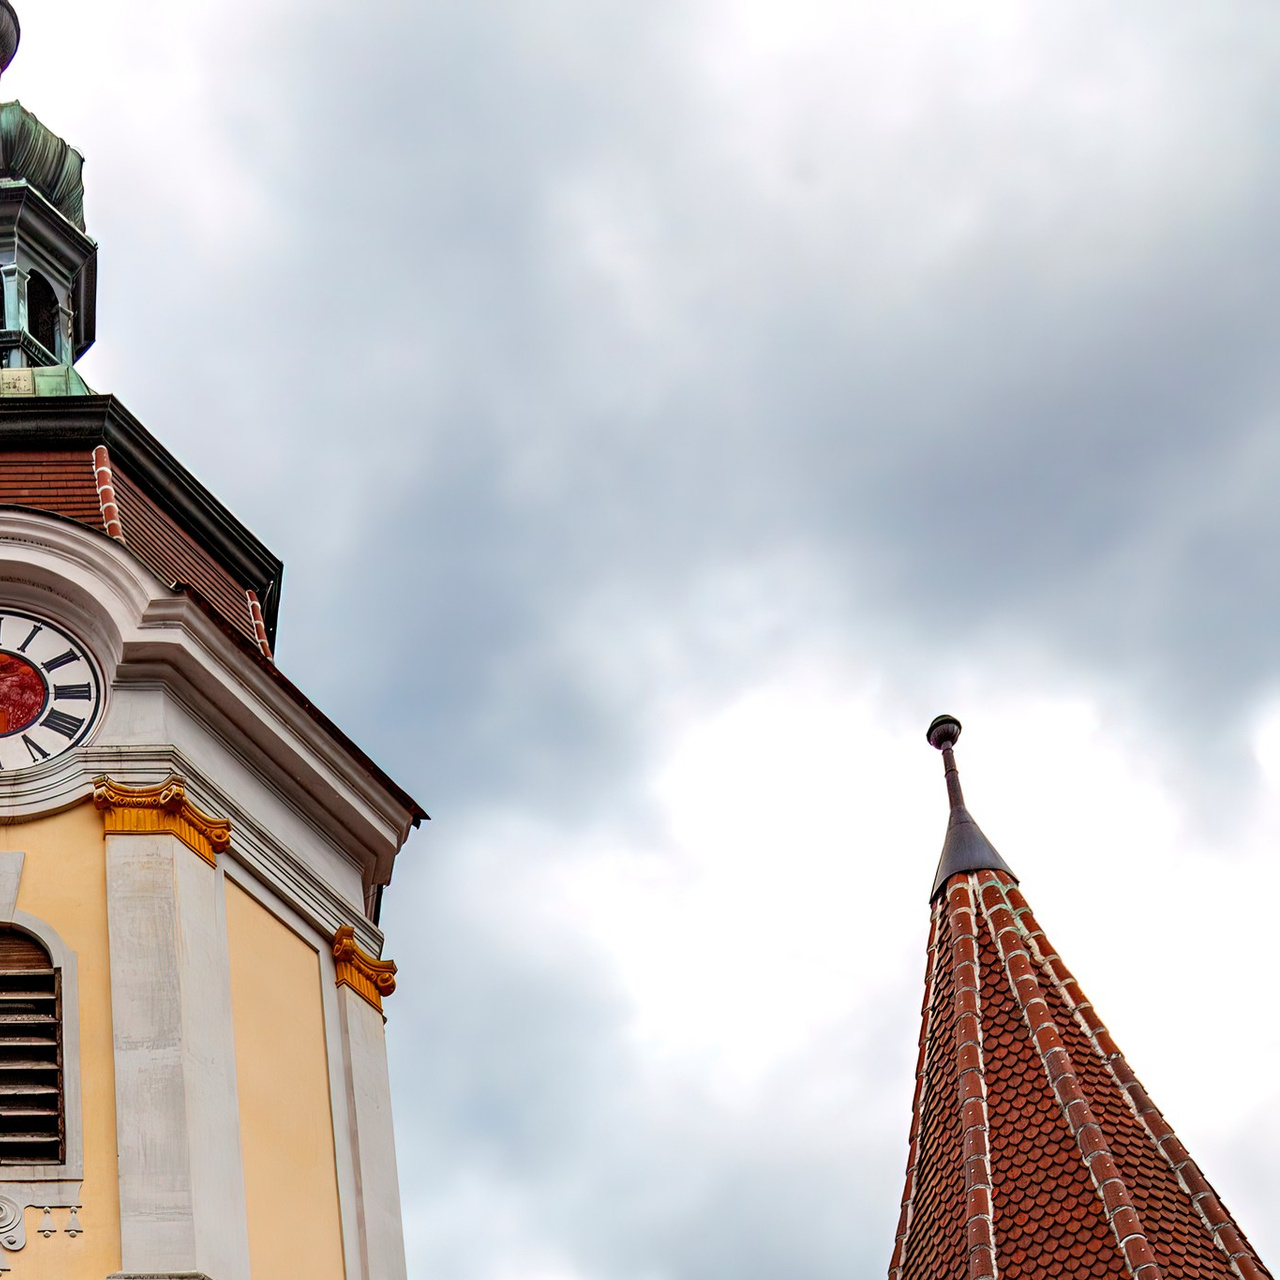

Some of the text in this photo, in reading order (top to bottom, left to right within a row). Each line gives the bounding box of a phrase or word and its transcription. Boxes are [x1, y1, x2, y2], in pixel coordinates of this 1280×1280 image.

[17, 622, 43, 653] I
[41, 648, 83, 674] II
[53, 681, 91, 701] III
[21, 733, 51, 763] V
